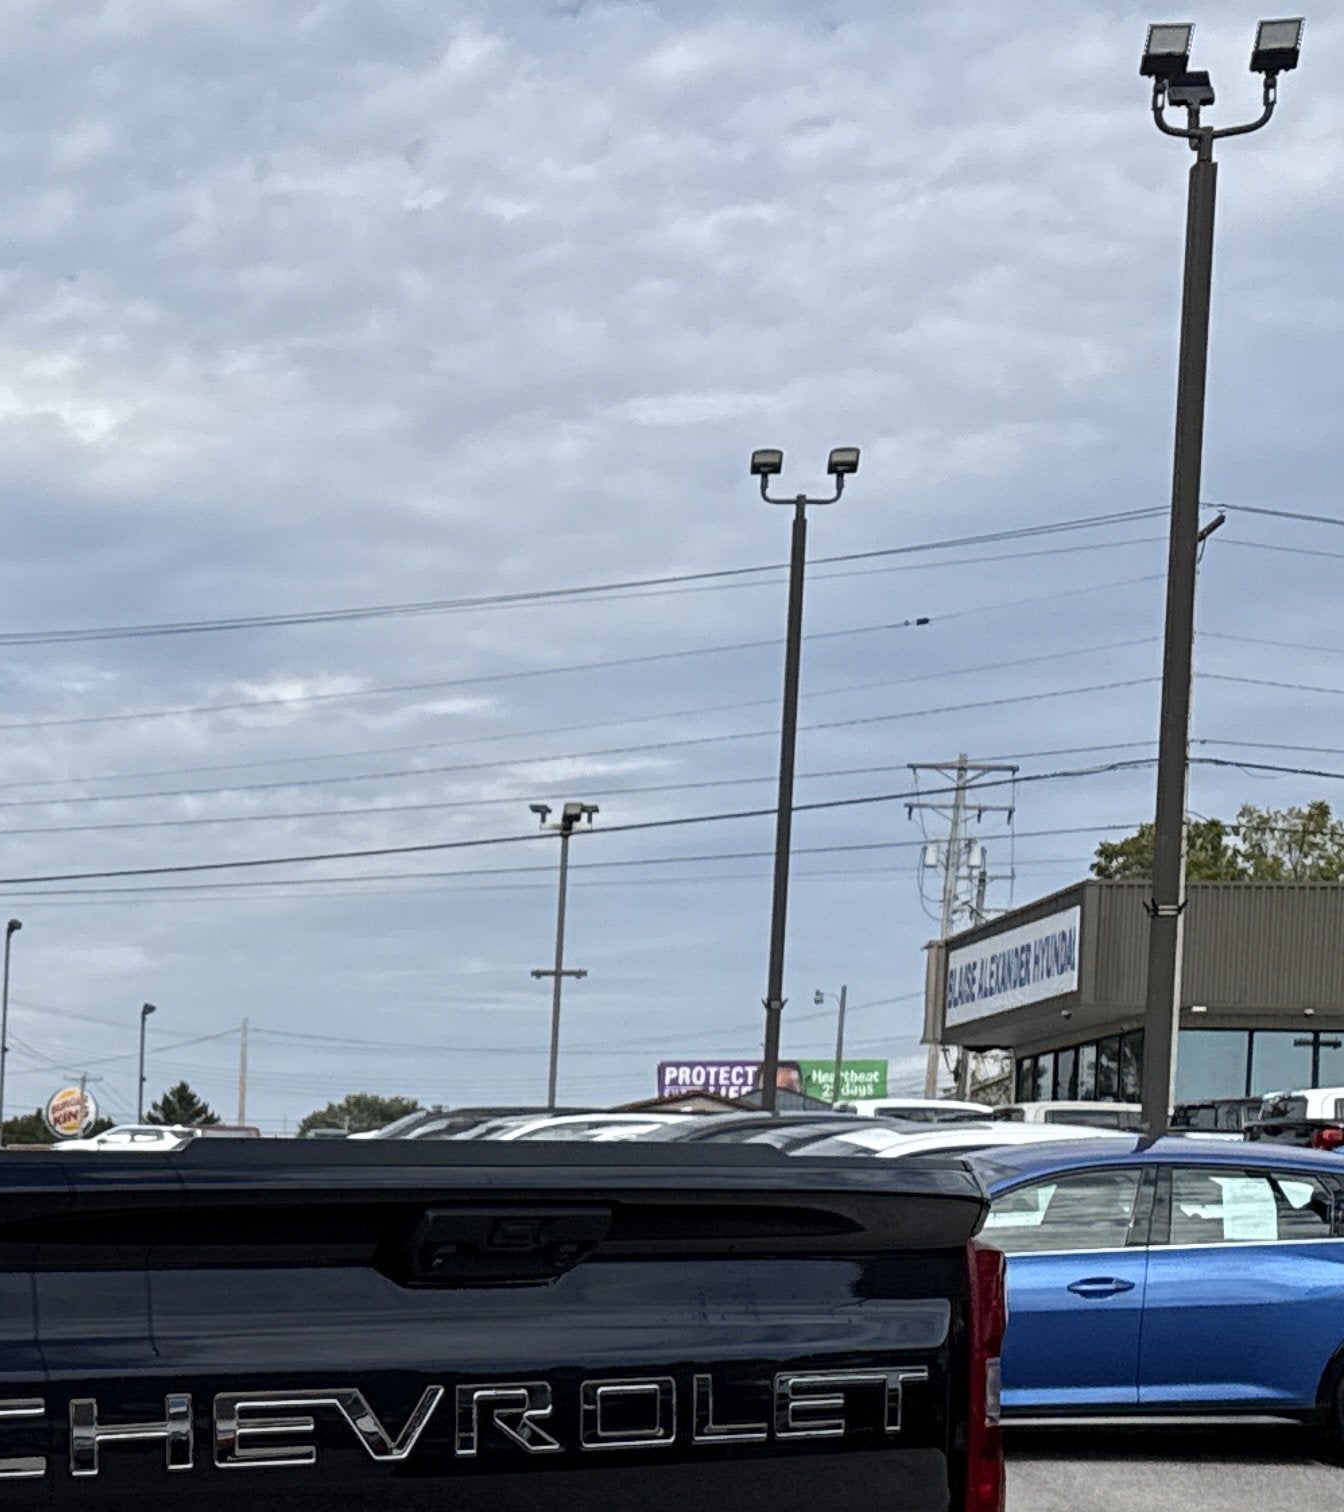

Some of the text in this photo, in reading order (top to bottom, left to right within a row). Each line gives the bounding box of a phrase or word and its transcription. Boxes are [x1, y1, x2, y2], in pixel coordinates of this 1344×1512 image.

[977, 942, 1032, 1000] ALEXANDER
[1032, 925, 1077, 984] HYUNDAI
[664, 1065, 758, 1086] PROTECT
[812, 1069, 880, 1084] Heatbeat
